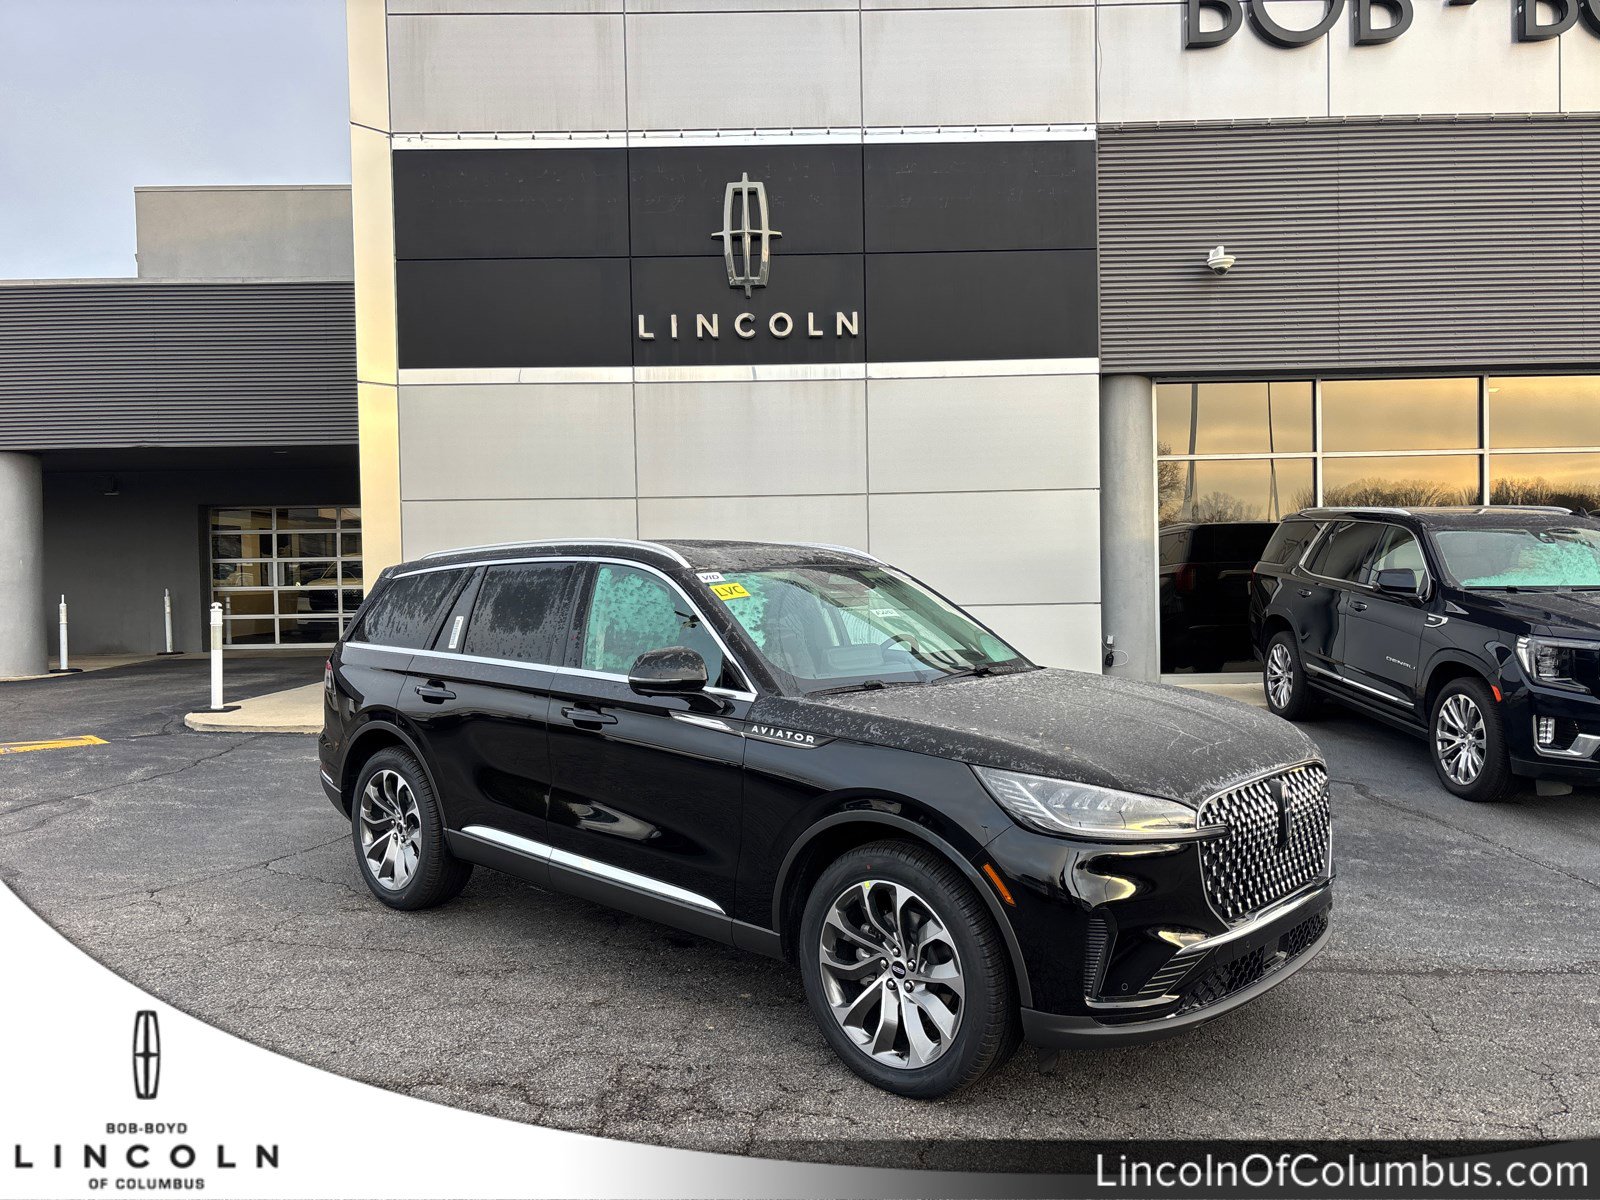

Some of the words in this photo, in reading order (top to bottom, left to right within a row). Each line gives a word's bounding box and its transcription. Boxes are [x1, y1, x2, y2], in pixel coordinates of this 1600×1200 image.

[638, 311, 859, 340] LINCOLN
[714, 585, 746, 597] LVC
[751, 725, 815, 744] AVIATOR
